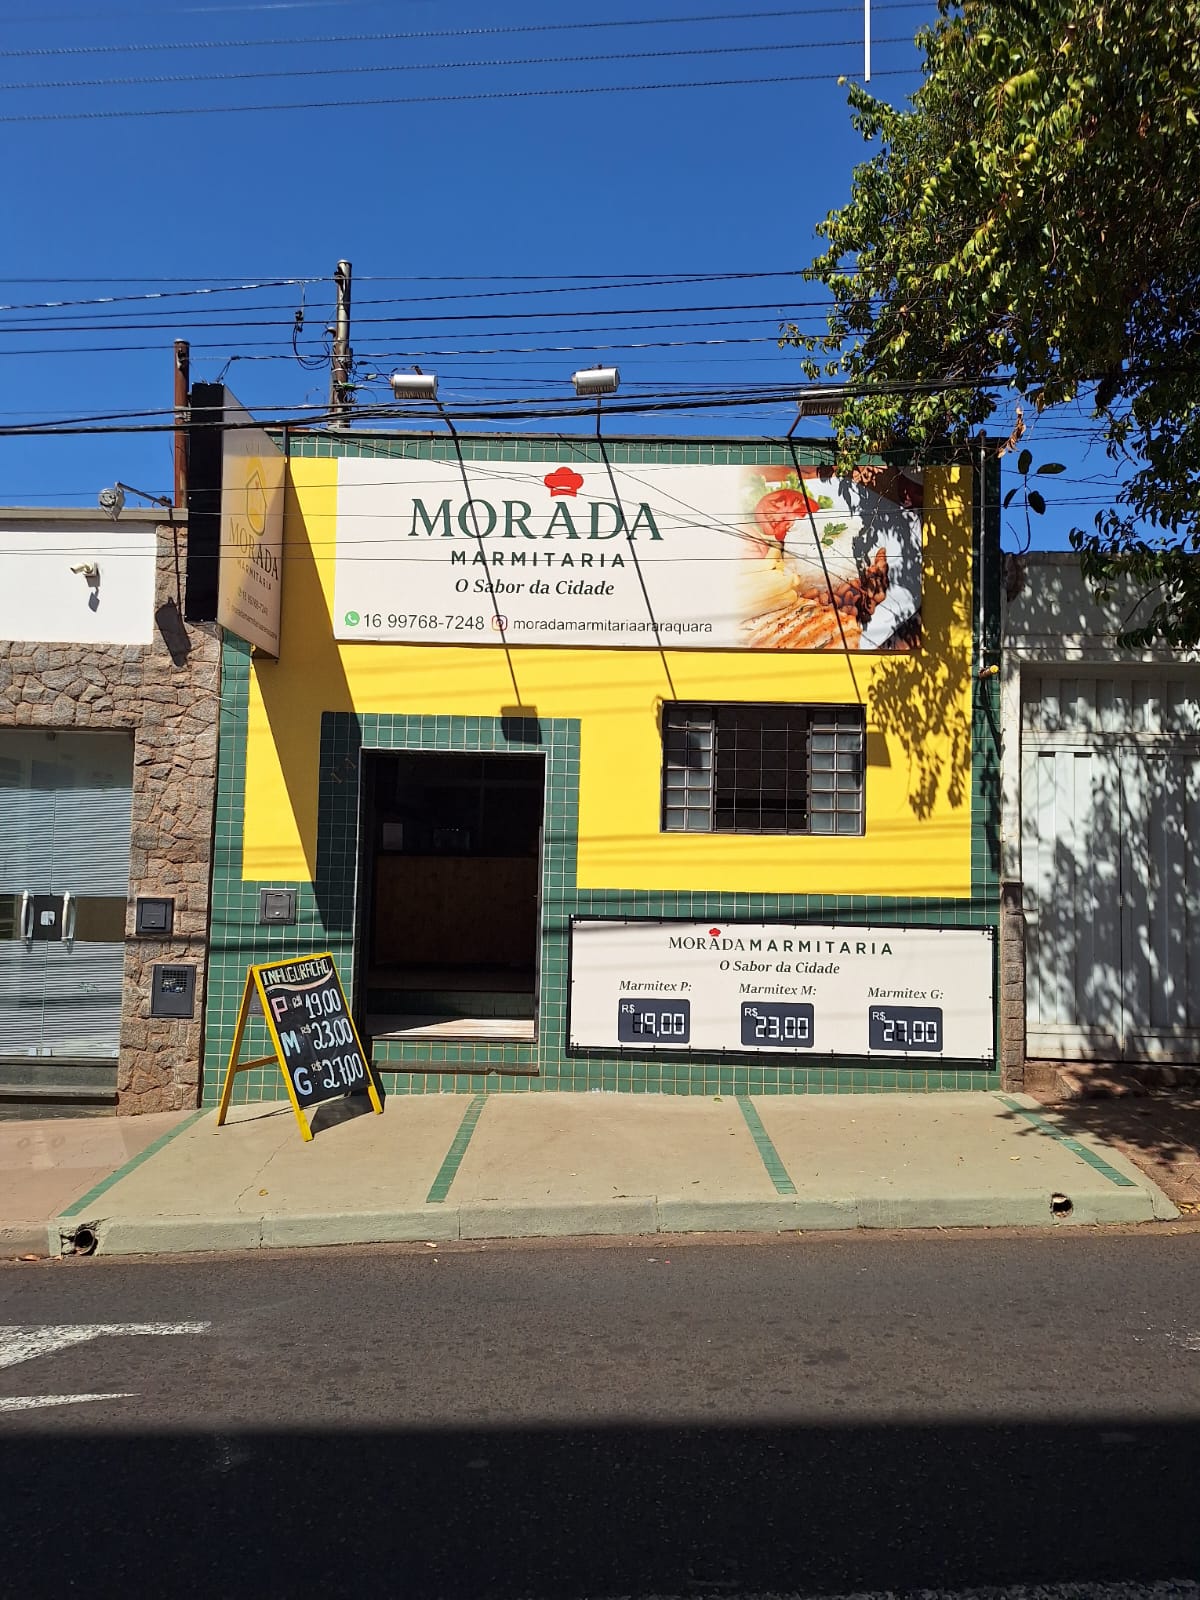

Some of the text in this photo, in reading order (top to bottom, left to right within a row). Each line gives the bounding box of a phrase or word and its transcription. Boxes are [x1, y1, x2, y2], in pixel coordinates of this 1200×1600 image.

[408, 498, 664, 541] MORADA
[229, 517, 279, 580] MORADA
[451, 550, 625, 568] MARMITARIA
[455, 578, 615, 596] O Sabor da Cidade
[363, 613, 485, 630] 16 99768-7248
[513, 618, 713, 635] moradamarmitariaararaquara
[668, 936, 893, 956] MORADA MARMITARIA
[719, 960, 841, 975] O Sabor da Cidade
[619, 980, 692, 992] Marmitex P:
[739, 983, 817, 996] Marmitex M:
[868, 987, 944, 1001] Marmitex G:
[271, 996, 288, 1023] P
[305, 987, 342, 1019] 19,00
[621, 1003, 685, 1036] R$ 19,00
[744, 1007, 809, 1041] R$ 23,00
[872, 1011, 937, 1045] R$ 27,00
[280, 1029, 301, 1057] M
[312, 1018, 354, 1050] 23,00
[293, 1066, 313, 1096] G
[321, 1052, 364, 1089] 27,00
